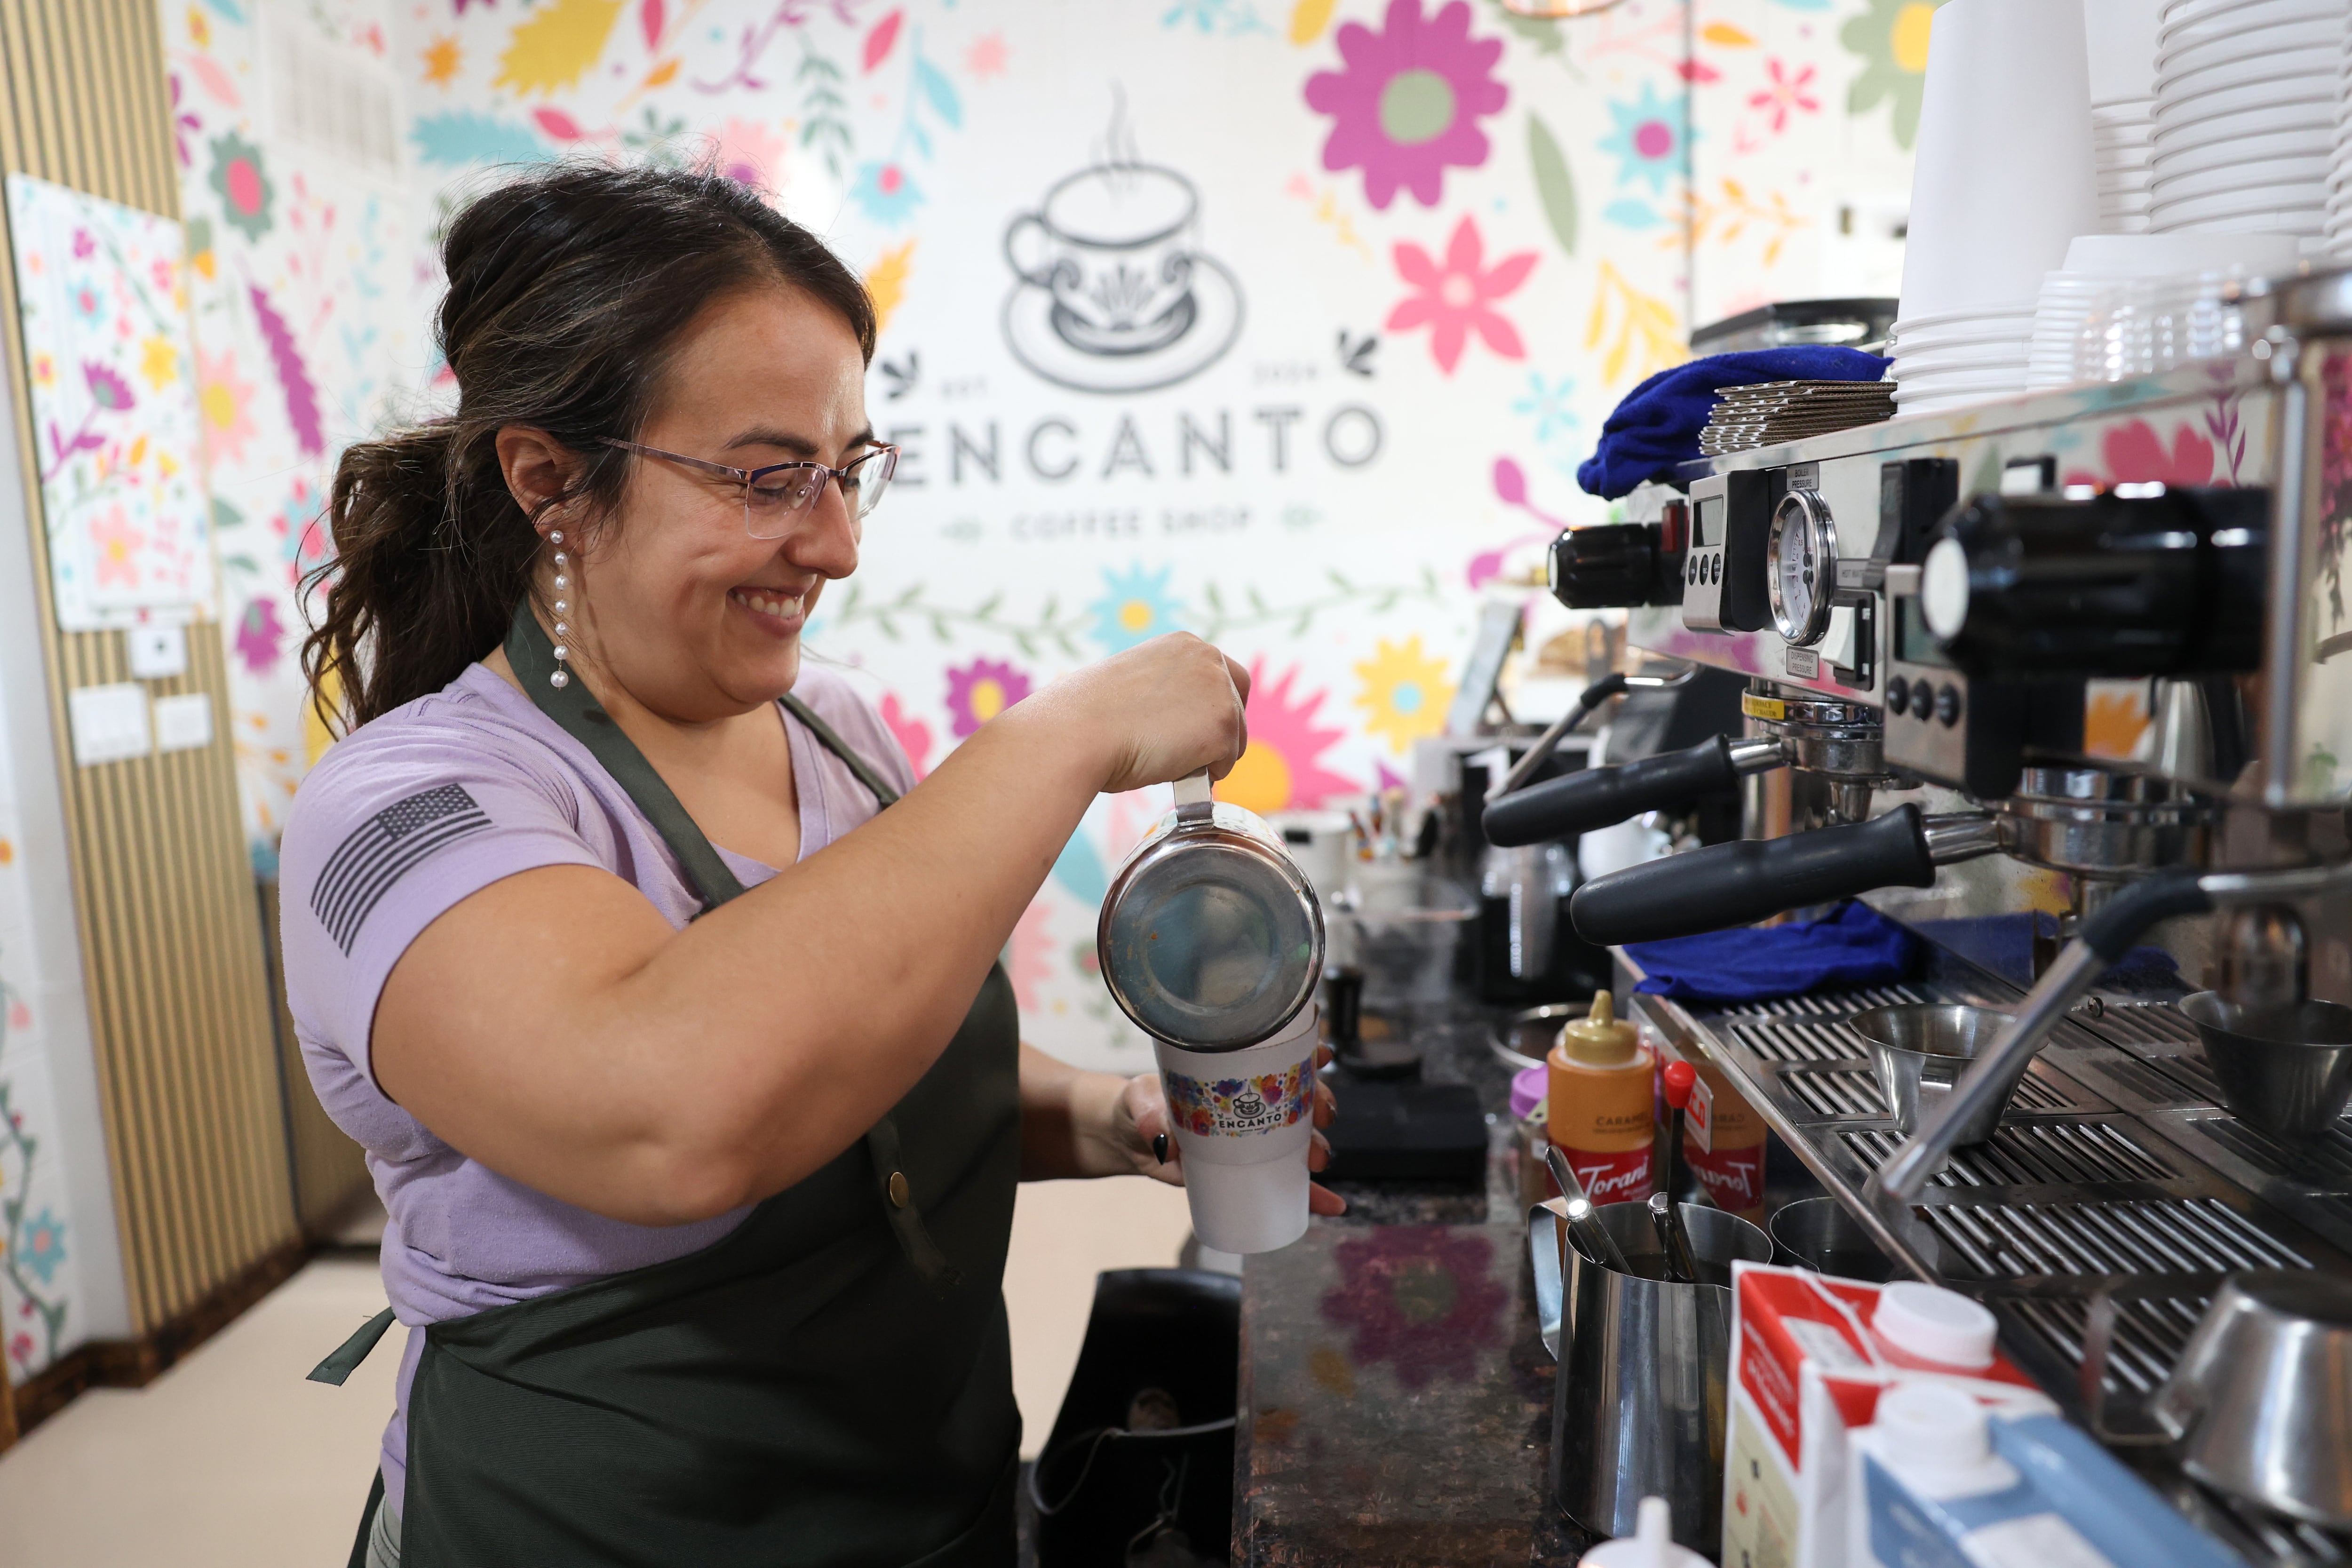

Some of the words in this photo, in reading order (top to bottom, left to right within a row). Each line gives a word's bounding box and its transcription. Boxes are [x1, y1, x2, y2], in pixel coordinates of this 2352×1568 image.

[888, 402, 1384, 487] ENCANTO
[1795, 468, 1809, 477] BOILER
[1792, 479, 1812, 488] PRESSURE
[1792, 662, 1812, 674] PRESSURE
[1219, 1114, 1281, 1128] ENCANTO
[1578, 1155, 1649, 1200] Torani
